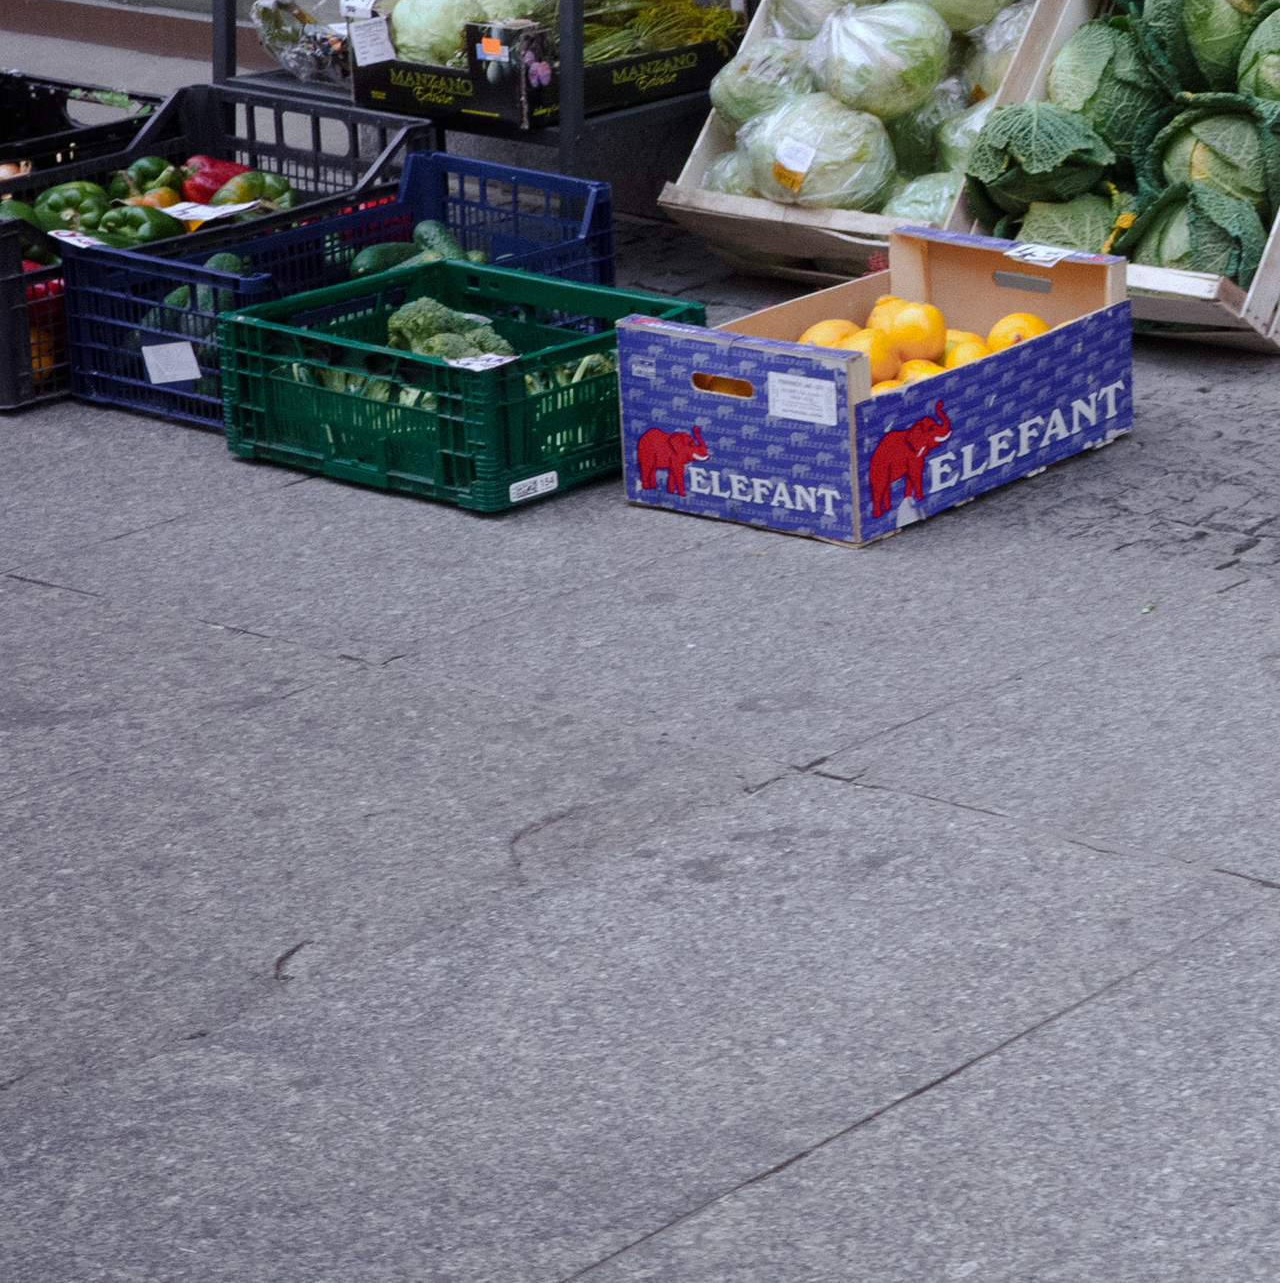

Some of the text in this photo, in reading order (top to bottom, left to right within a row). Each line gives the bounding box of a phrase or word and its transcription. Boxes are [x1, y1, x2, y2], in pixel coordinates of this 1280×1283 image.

[389, 67, 474, 97] MANZANO
[612, 52, 698, 85] MANZANO
[928, 379, 1126, 495] ELEFANT
[688, 465, 842, 517] ELEFANT
